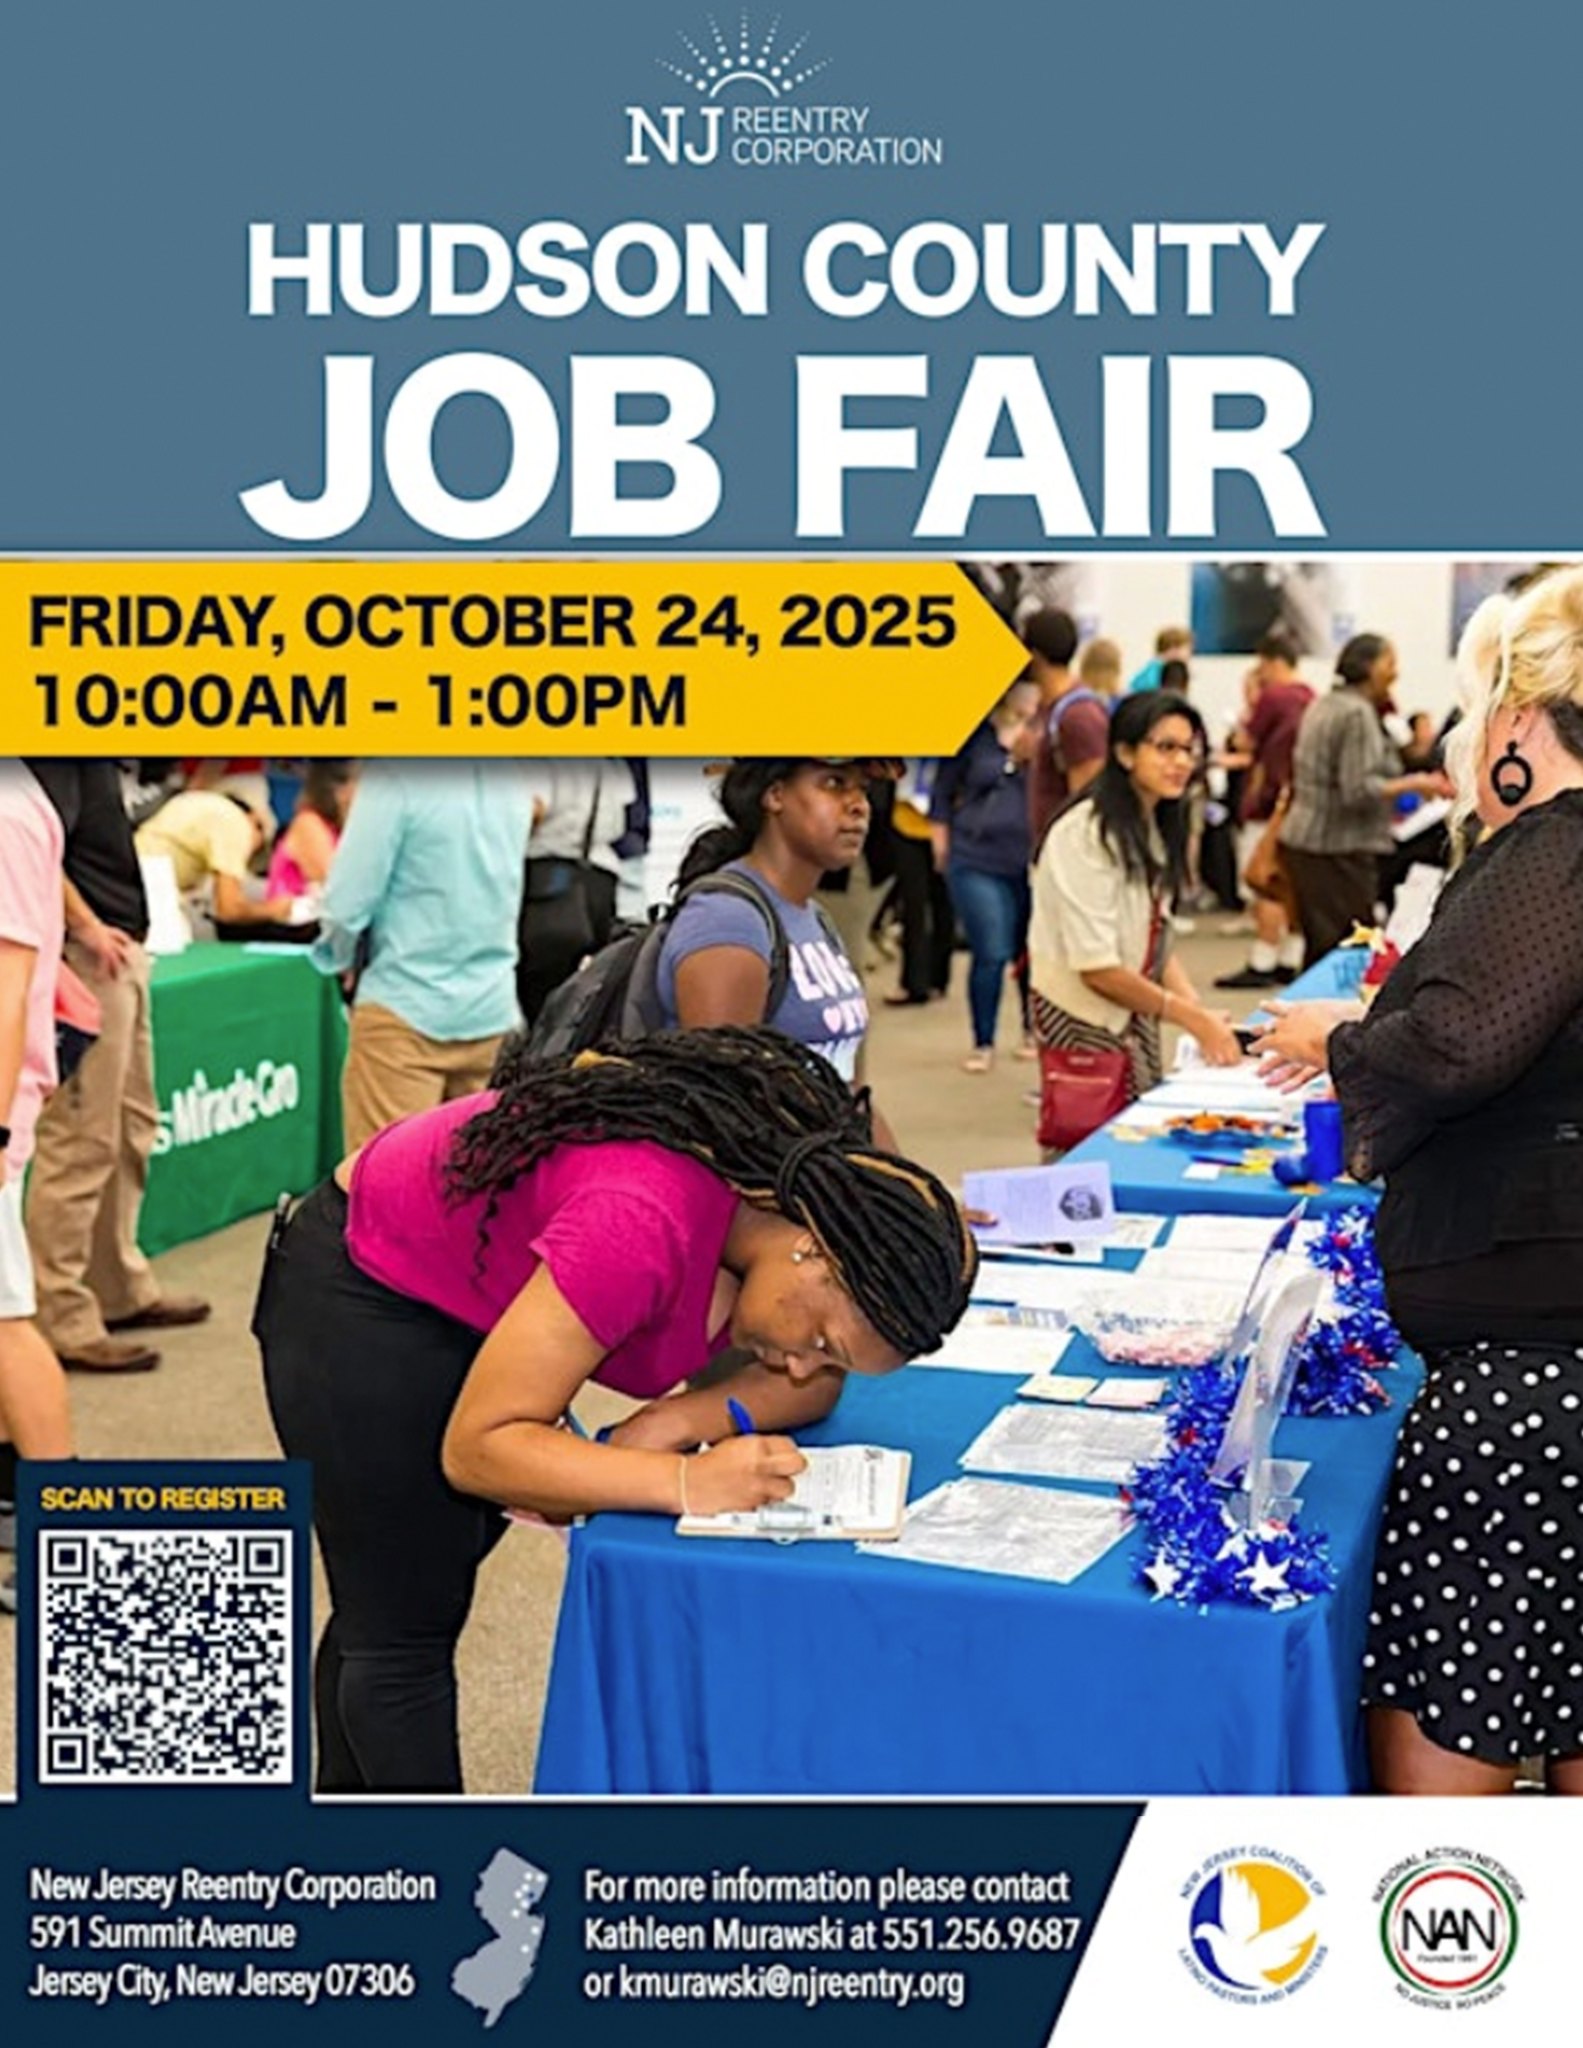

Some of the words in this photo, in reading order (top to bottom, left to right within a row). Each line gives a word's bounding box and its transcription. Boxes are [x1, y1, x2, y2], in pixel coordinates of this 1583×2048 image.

[626, 107, 724, 164] NJ
[733, 106, 869, 133] REENTRY
[732, 138, 942, 164] CORPORATION
[248, 221, 767, 317] HUDSON
[804, 222, 1325, 317] COUNTY
[239, 352, 721, 540] JOB
[796, 355, 1326, 536] FAIR
[31, 595, 285, 656] FRIDAY,
[305, 594, 636, 648] OCTOBER
[657, 594, 760, 656] 24,
[780, 594, 956, 648] 2025
[35, 674, 346, 727] 10:00AM
[373, 701, 397, 712] -
[428, 674, 686, 727] 1:00PM
[40, 1487, 114, 1510] SCAN
[118, 1487, 156, 1510] TO
[161, 1487, 286, 1510] REGISTER
[31, 1869, 90, 1900] New
[92, 1869, 177, 1909] Jersey
[182, 1868, 281, 1909] Reentry
[285, 1867, 436, 1908] Corporation
[586, 1869, 628, 1901] For
[634, 1877, 706, 1901] more
[713, 1866, 870, 1901] information
[879, 1868, 966, 1910] please
[973, 1873, 1069, 1901] contact
[1180, 1870, 1201, 1899] NEW
[1202, 1846, 1246, 1872] JERSEY
[1250, 1845, 1313, 1882] COALITION
[1372, 1854, 1420, 1903] NATIONAL
[1425, 1847, 1473, 1860] ACTION
[1476, 1853, 1526, 1903] NETWORK
[31, 1915, 80, 1948] 591
[89, 1915, 194, 1948] Summit
[196, 1916, 296, 1948] Avenue
[586, 1916, 705, 1950] Kathleen
[714, 1916, 843, 1950] Murawski
[850, 1921, 876, 1950] at
[883, 1917, 1080, 1950] 551.256.9687
[1403, 1908, 1495, 1951] NAN
[29, 1964, 113, 2005] Jersey
[117, 1963, 171, 2005] City,
[177, 1964, 235, 1996] New
[238, 1964, 322, 2005] Jersey
[325, 1963, 414, 1996] 07306
[584, 1973, 613, 1997] or
[620, 1964, 964, 2007] kmurawski@njreentry.org
